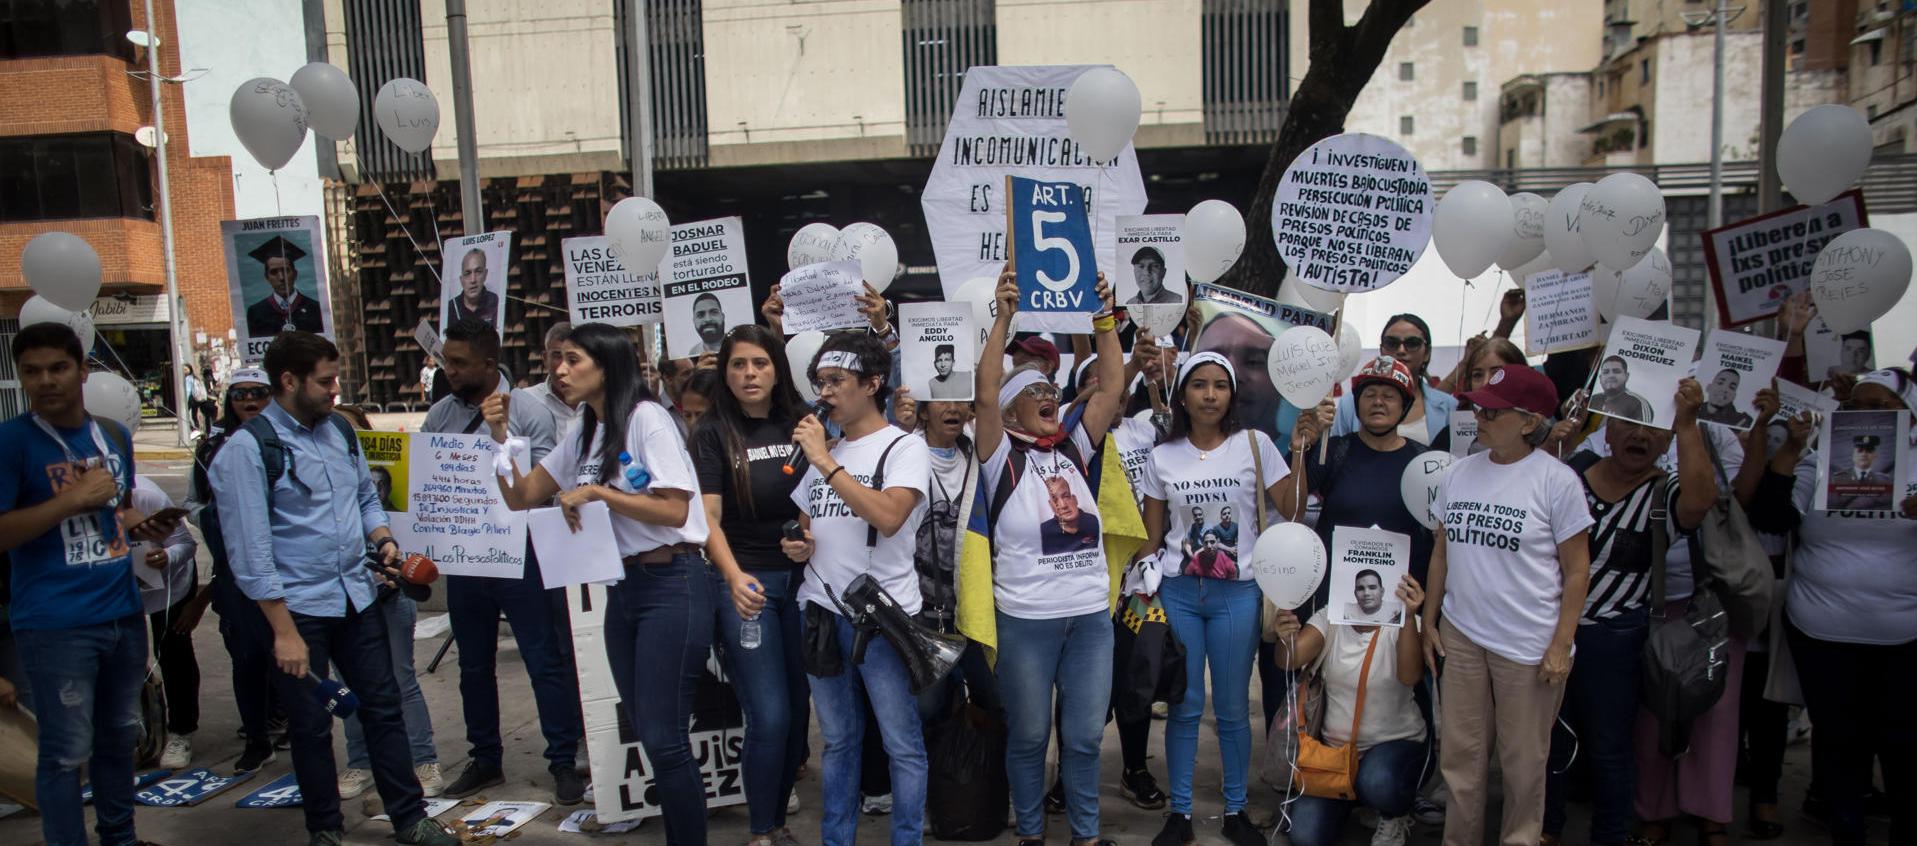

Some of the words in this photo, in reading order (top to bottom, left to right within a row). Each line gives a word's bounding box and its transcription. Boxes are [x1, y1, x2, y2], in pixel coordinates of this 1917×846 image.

[1291, 170, 1348, 188] MUERTES
[1351, 173, 1376, 191] BAJO
[1377, 177, 1428, 198] CUSTODIA
[970, 183, 991, 213] ES
[1031, 183, 1074, 206] ART.
[241, 219, 266, 231] JUAN
[266, 217, 300, 230] FREITES
[1281, 218, 1333, 236] PRESOS
[1333, 209, 1347, 224] DE
[1348, 211, 1389, 230] CASOS
[1395, 216, 1412, 231] DE
[671, 224, 725, 241] JOSNAR
[1118, 236, 1140, 244] EXAR
[1141, 235, 1181, 243] CASTILLO
[1728, 216, 1823, 257] ¡Liberen
[1827, 211, 1842, 228] a
[462, 237, 476, 246] LUIS
[672, 239, 728, 257] BADUEL
[1279, 231, 1322, 250] PORQUE
[1327, 238, 1345, 252] NO
[1346, 242, 1362, 255] SE
[1365, 241, 1415, 263] LIBERAN
[570, 248, 601, 262] LAS
[1031, 209, 1081, 292] 5
[1285, 245, 1306, 259] LOS
[1311, 248, 1356, 266] PRESOS
[672, 257, 693, 269] está
[695, 253, 728, 266] siendo
[577, 273, 620, 287] ESTÁN
[673, 263, 733, 281] torturado
[671, 284, 686, 295] EN
[687, 282, 700, 292] EL
[702, 276, 740, 290] RODEO
[577, 286, 650, 303] INOCENTES
[1031, 291, 1083, 309] CRBV
[578, 300, 662, 320] TERRORIS
[1193, 283, 1276, 318] LIBERTAD
[1281, 307, 1327, 332] PARA
[919, 335, 954, 343] ANGULO
[924, 327, 948, 335] EDDY
[1617, 348, 1676, 367] RODRIGUEZ
[1632, 343, 1665, 356] DIXON
[1719, 360, 1754, 372] TORRES
[1721, 352, 1754, 365] MAIKEL
[379, 436, 402, 452] DÍAS
[430, 436, 465, 450] Medio
[434, 451, 442, 461] 6
[450, 453, 479, 462] Meses
[453, 474, 482, 484] horas
[1172, 481, 1192, 492] NO
[1193, 477, 1240, 489] SOMOS
[453, 484, 488, 495] Minutos
[452, 493, 498, 506] Segundos
[1185, 491, 1228, 505] PDVSA
[1446, 501, 1482, 512] LIBEREN
[1483, 503, 1491, 513] A
[1492, 504, 1527, 520] TODOS
[412, 523, 446, 535] Contra
[1465, 512, 1523, 535] PRESOS
[1037, 554, 1075, 566] PERIODISTA
[1342, 556, 1396, 567] MONTESINO
[1347, 550, 1393, 560] FRANKLIN
[1054, 563, 1065, 571] NO
[1065, 562, 1074, 570] ES
[1074, 559, 1093, 569] DELITO
[623, 746, 646, 780] A
